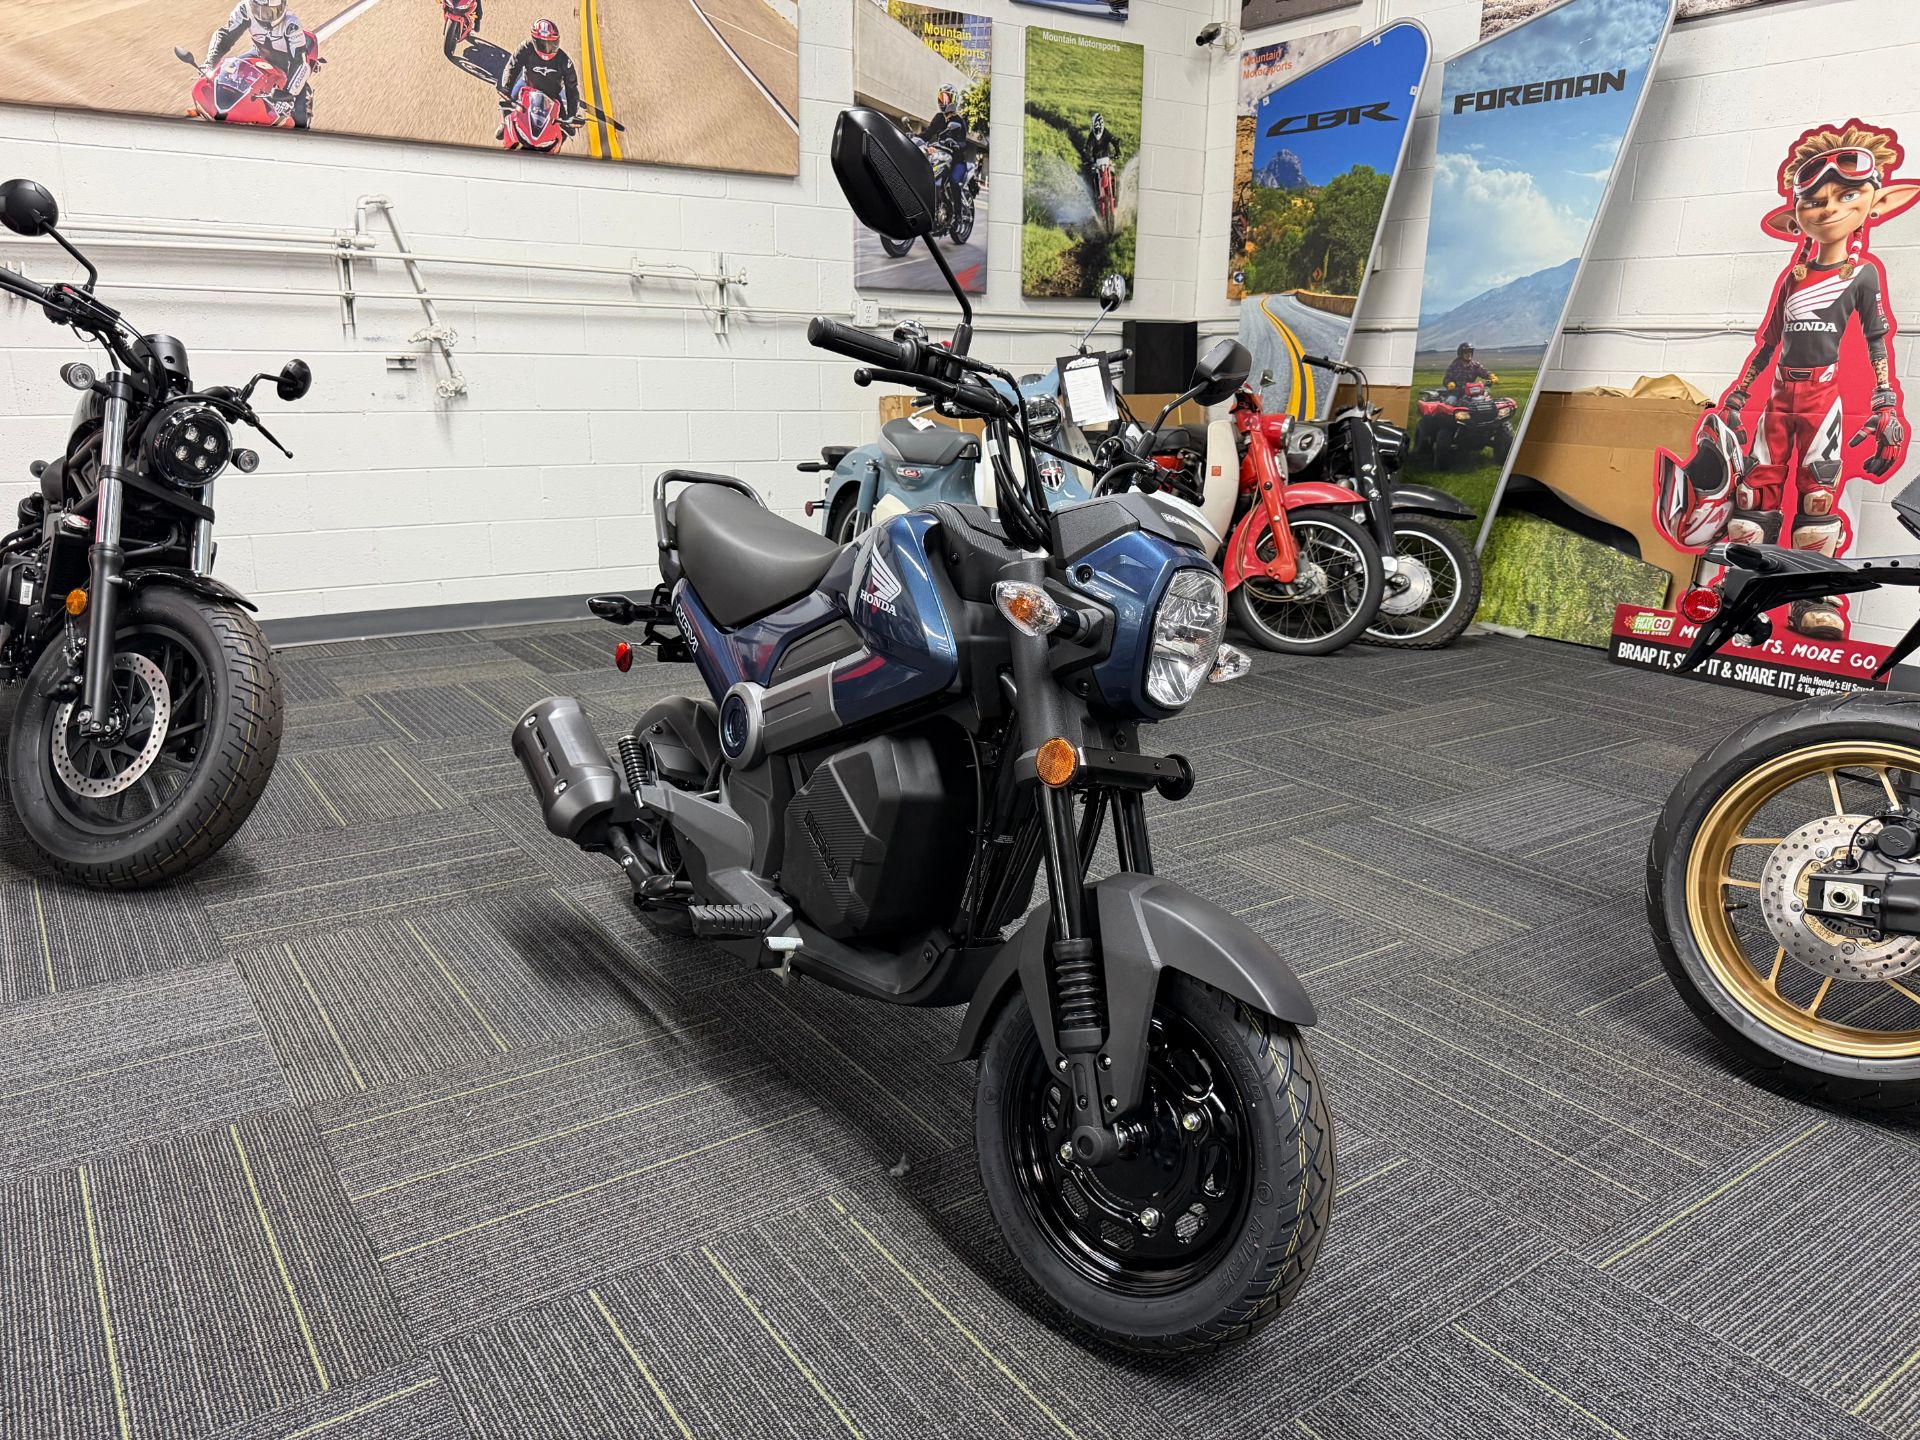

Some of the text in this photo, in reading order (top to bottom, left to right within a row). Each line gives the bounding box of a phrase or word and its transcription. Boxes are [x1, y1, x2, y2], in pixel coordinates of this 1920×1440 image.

[924, 22, 972, 41] Mountain
[1042, 31, 1121, 53] Mountain Motorsports
[924, 38, 986, 60] Motorsports
[1243, 47, 1283, 66] Mountain
[1242, 60, 1293, 80] Motorsports
[1453, 69, 1626, 115] FOREMAN
[1265, 101, 1399, 137] CBR
[1784, 321, 1838, 333] HONDA
[860, 589, 897, 617] HONDA
[1653, 618, 1671, 630] GO
[1617, 642, 1657, 664] BRAAP
[1657, 649, 1671, 670] IT,
[1707, 658, 1720, 676] IT
[1720, 661, 1732, 679] &
[1734, 663, 1777, 687] SHARE
[1778, 671, 1796, 691] IT!
[1791, 643, 1845, 664] MORE
[1850, 653, 1879, 670] GO.
[1796, 683, 1803, 692] &
[1804, 684, 1816, 696] Tag
[1798, 673, 1813, 684] Join
[1813, 676, 1841, 690] Honda's
